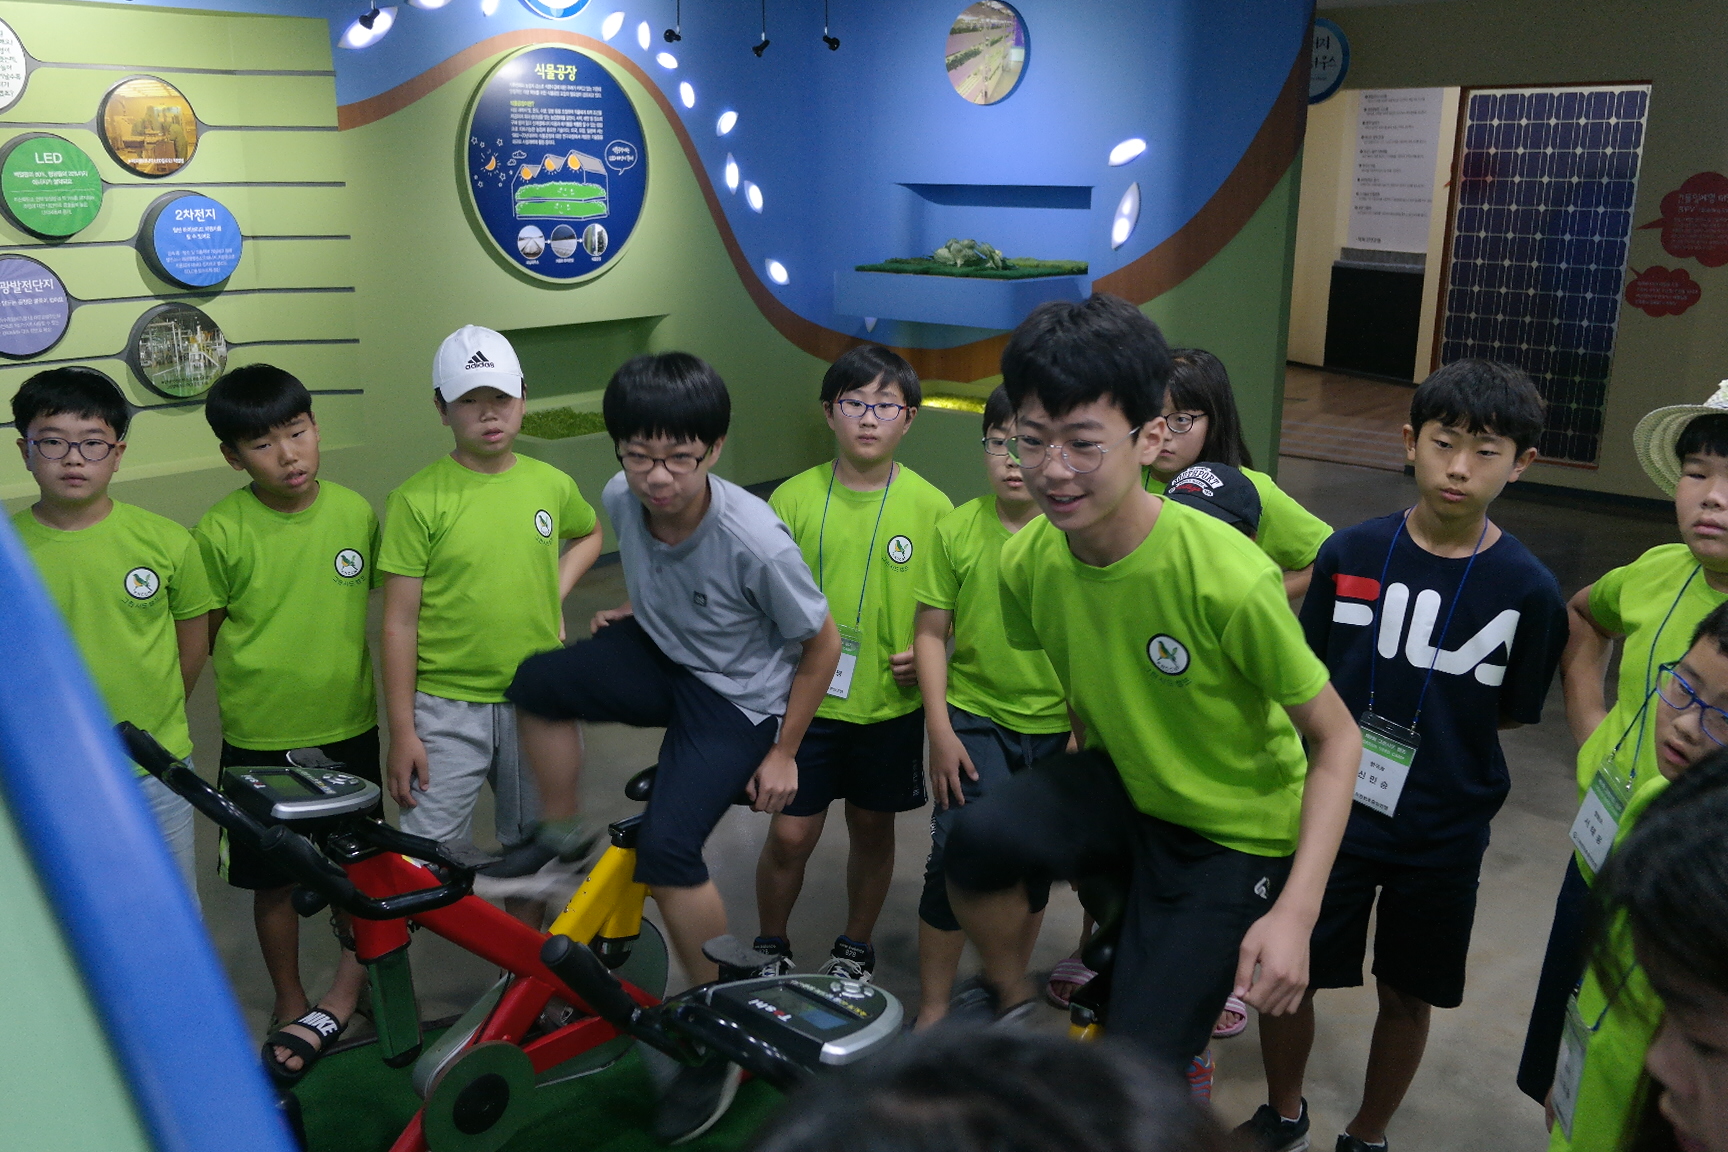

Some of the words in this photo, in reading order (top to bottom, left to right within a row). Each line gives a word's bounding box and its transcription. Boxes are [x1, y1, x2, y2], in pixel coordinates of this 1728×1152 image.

[534, 63, 578, 81] 식물공장
[34, 152, 63, 164] LED
[174, 208, 216, 222] 2차전지
[0, 279, 54, 294] 광발전단지
[465, 361, 495, 370] adidas
[1331, 573, 1522, 687] FILA
[297, 1011, 338, 1037] NIKE
